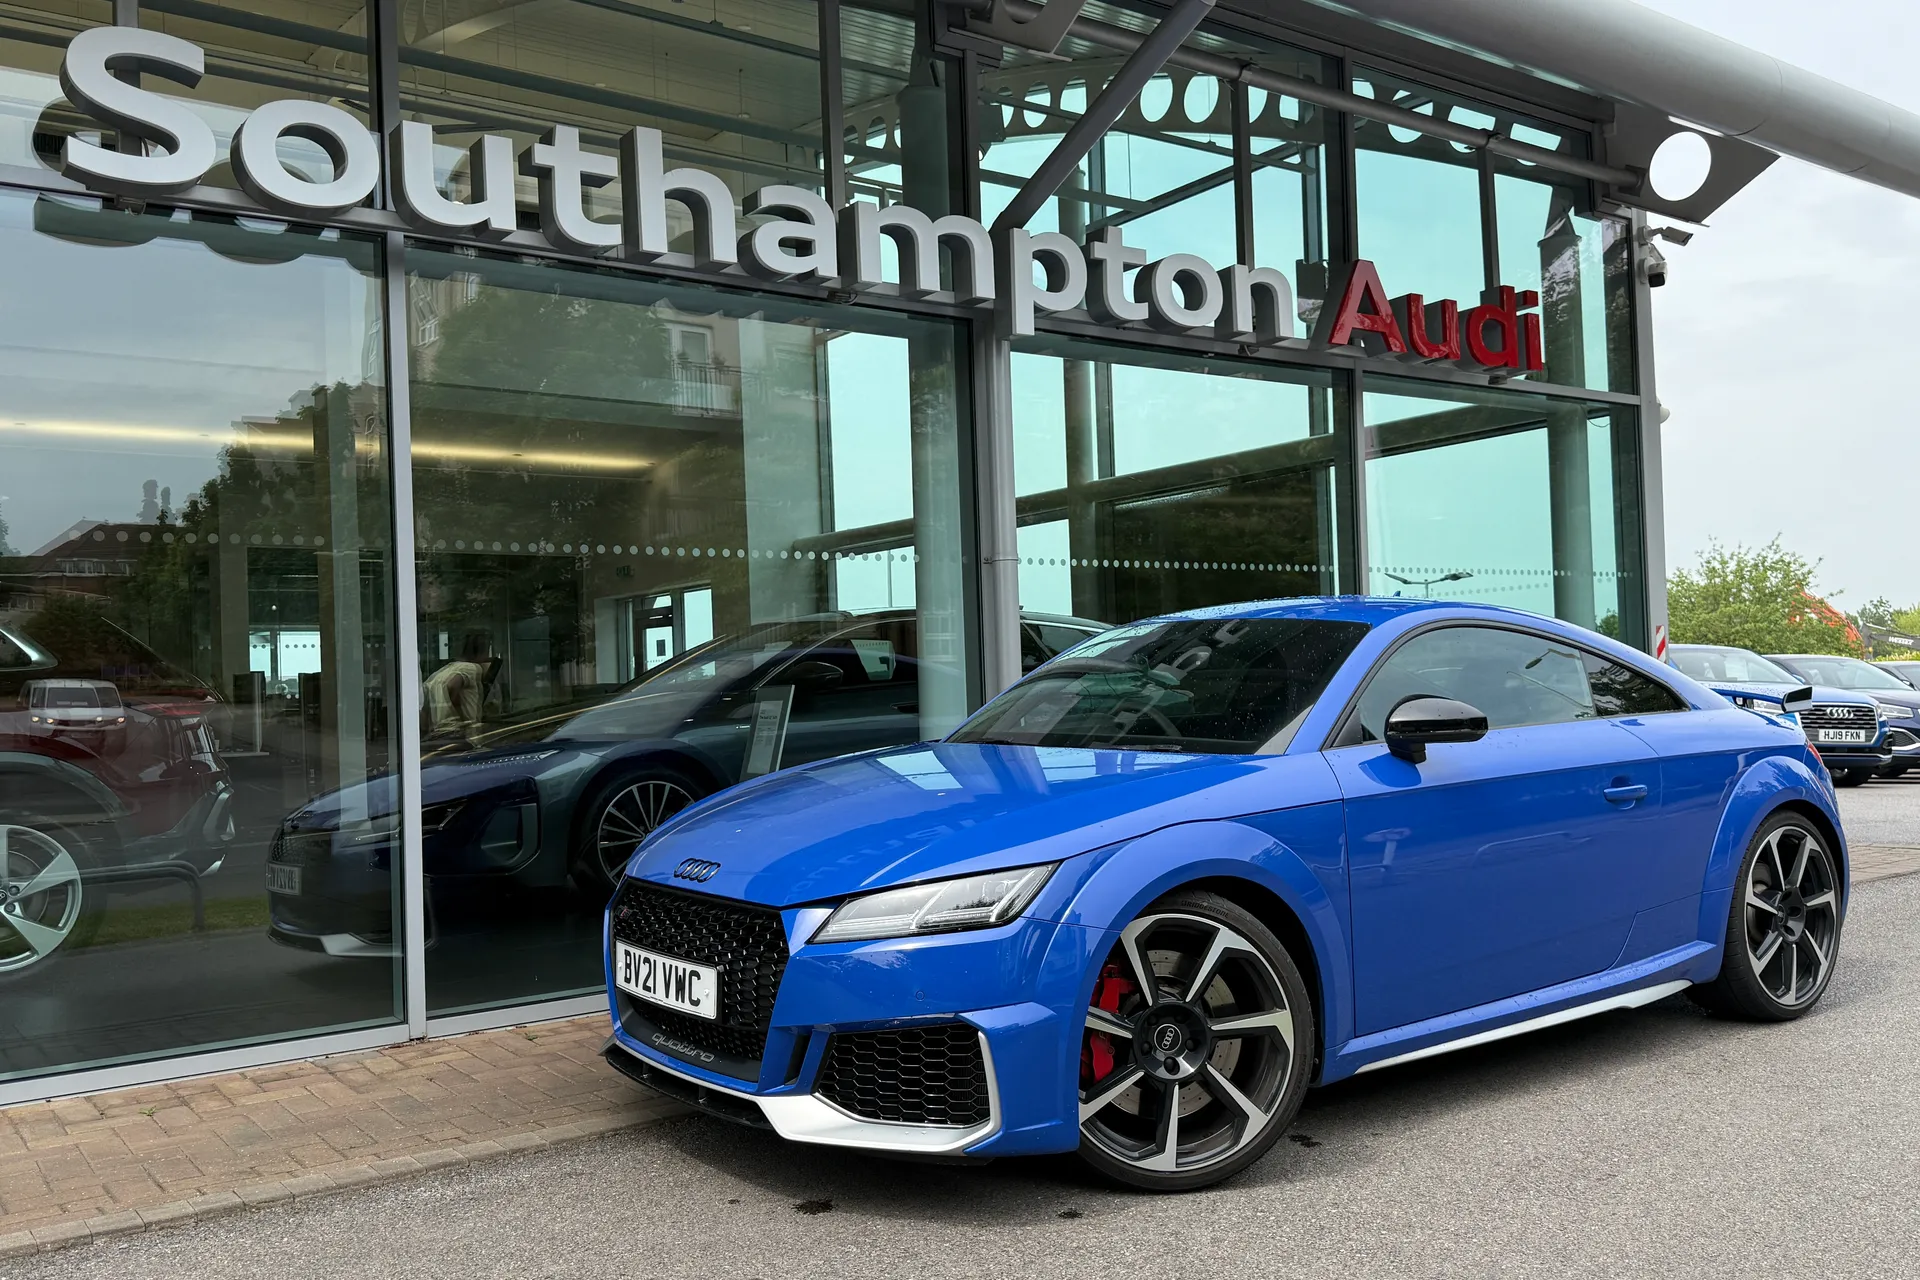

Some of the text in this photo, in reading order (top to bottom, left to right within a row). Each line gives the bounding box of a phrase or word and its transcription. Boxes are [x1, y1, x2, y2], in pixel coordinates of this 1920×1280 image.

[62, 26, 1543, 371] Southampton Audi
[1823, 730, 1861, 740] HJ19 FKN
[624, 948, 701, 1007] BV21 VWC
[651, 1032, 715, 1063] quattro
